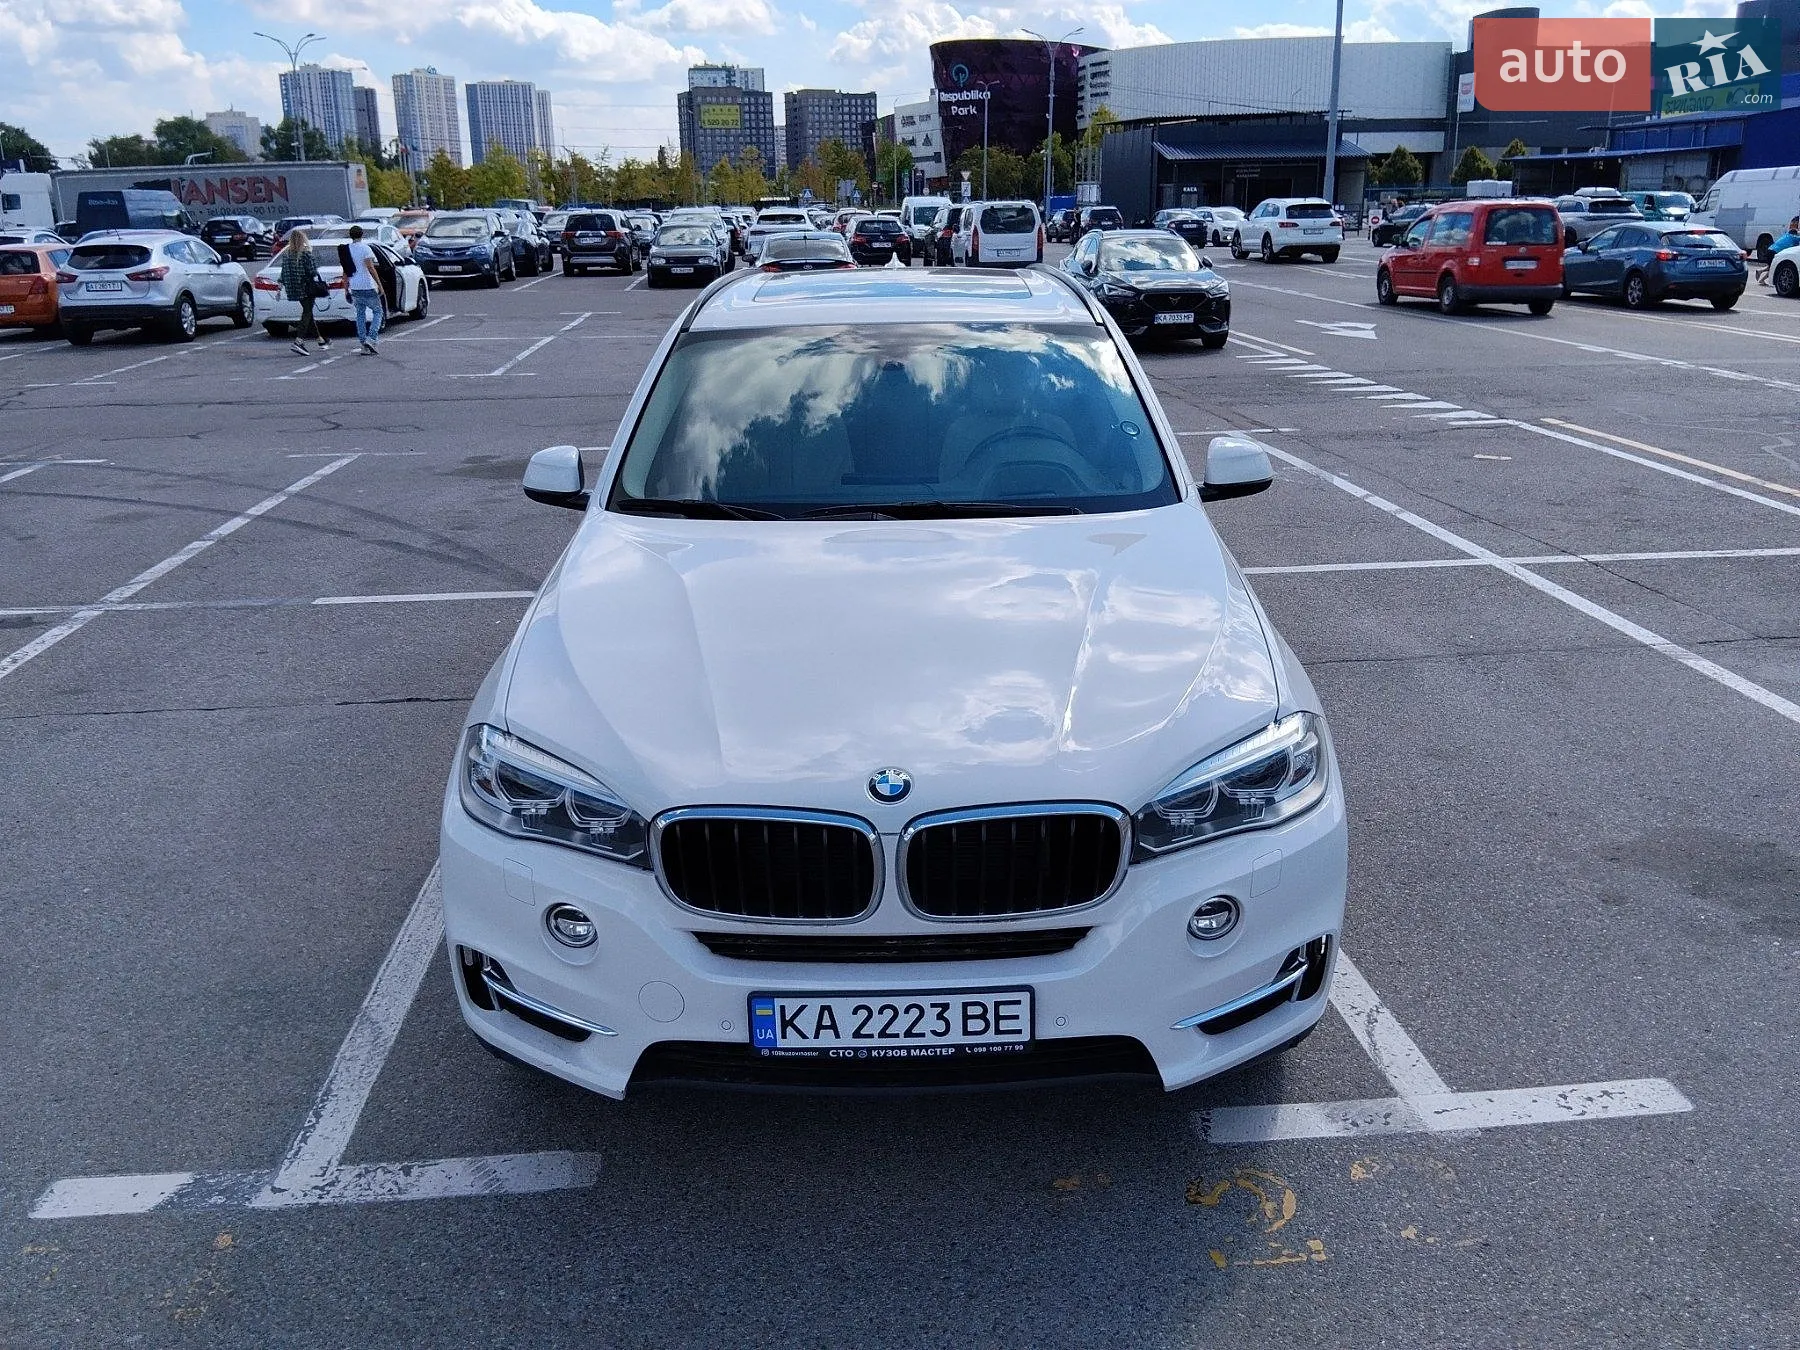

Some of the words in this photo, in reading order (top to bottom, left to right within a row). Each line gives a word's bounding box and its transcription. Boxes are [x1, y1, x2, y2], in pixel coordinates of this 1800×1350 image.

[939, 90, 991, 103] Respublika
[951, 104, 977, 116] Park
[778, 1003, 841, 1040] KA
[851, 1002, 952, 1039] 2223
[961, 999, 1023, 1037] BE
[756, 1028, 774, 1040] UA
[829, 1049, 854, 1057] СТО
[871, 1049, 908, 1057] КУЗОВ
[910, 1047, 956, 1057] МАСТЕР
